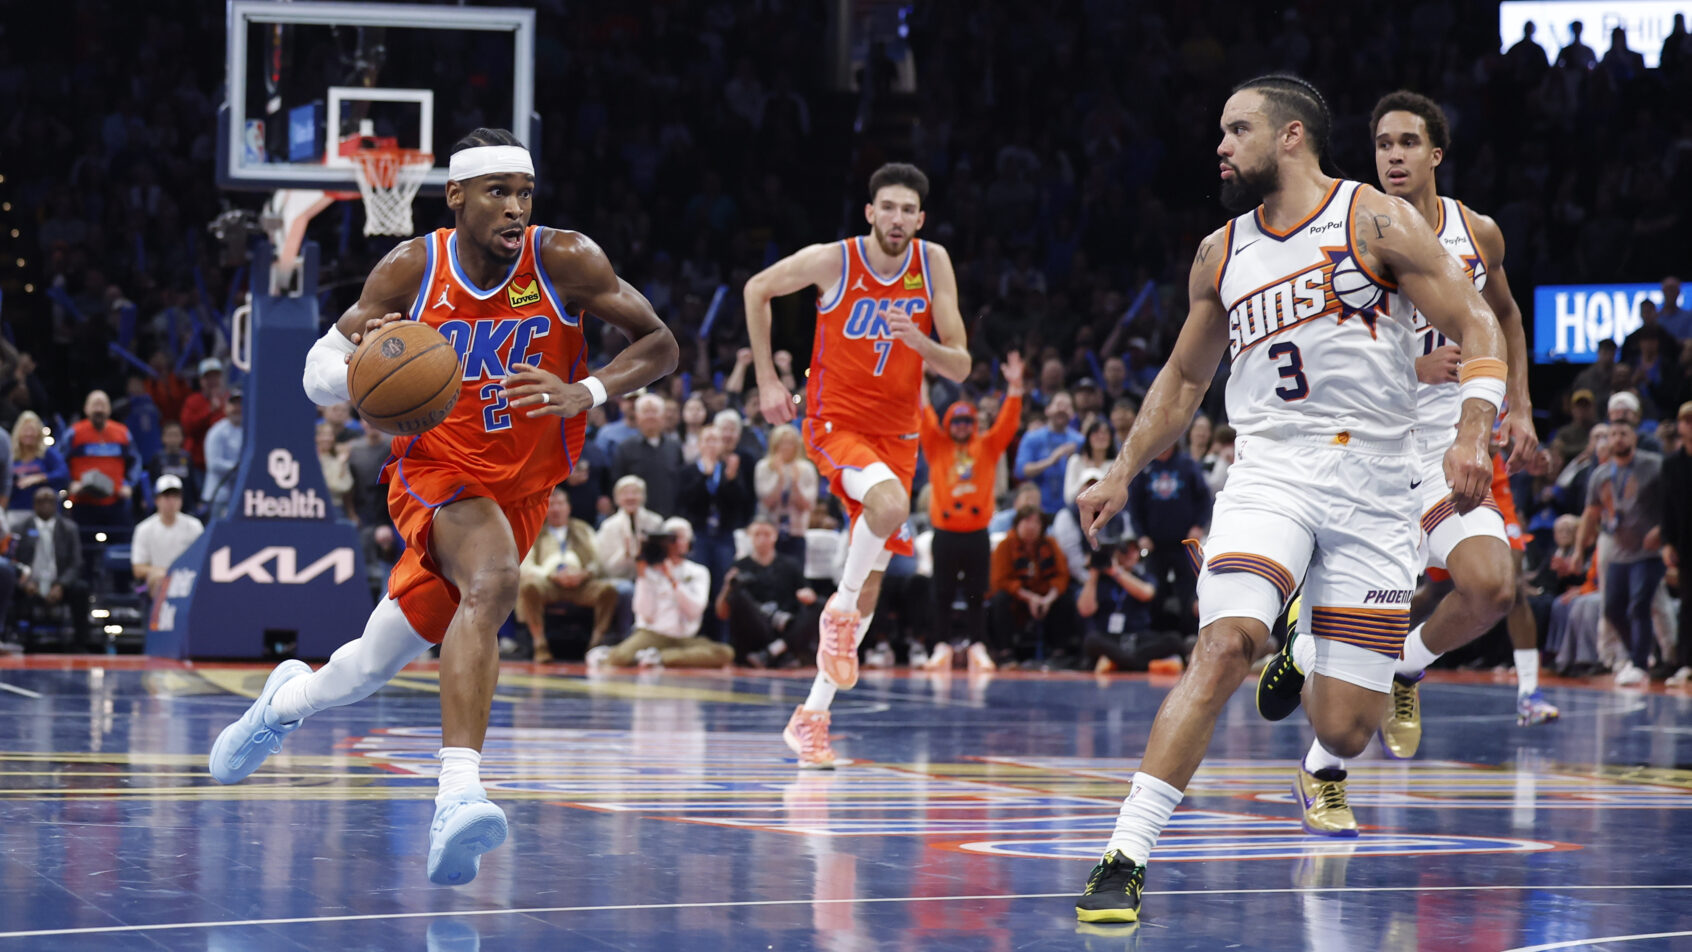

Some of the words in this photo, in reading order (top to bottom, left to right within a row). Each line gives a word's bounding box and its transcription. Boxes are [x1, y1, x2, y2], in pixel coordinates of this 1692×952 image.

[1310, 221, 1343, 234] PayPal
[1228, 269, 1326, 362] SUNS
[1554, 290, 1666, 354] HOM
[438, 315, 551, 382] OKC
[873, 341, 893, 377] 7
[1268, 341, 1310, 402] 3
[480, 383, 512, 433] 2
[268, 448, 300, 489] OU
[244, 488, 326, 519] Health
[210, 546, 355, 585] KIA
[1363, 589, 1415, 604] PHOENI
